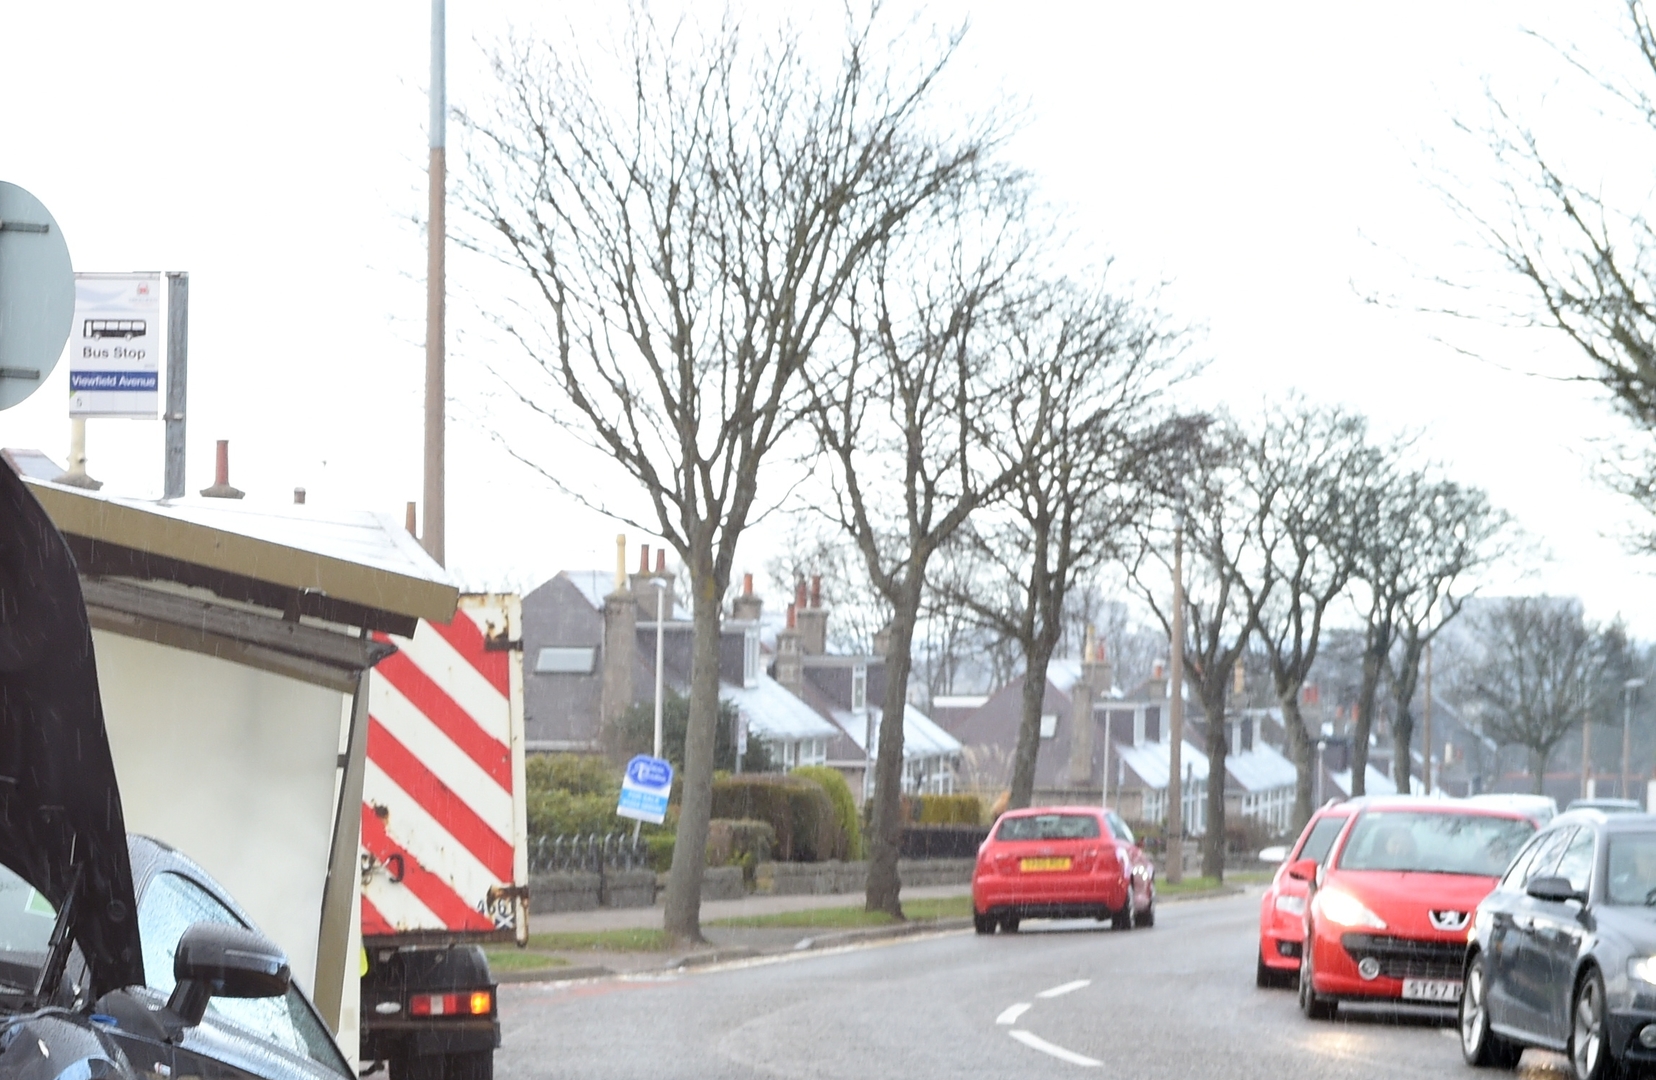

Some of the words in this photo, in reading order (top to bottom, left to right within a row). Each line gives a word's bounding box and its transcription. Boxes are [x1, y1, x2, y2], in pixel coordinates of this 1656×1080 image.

[83, 346, 109, 358] Bus
[114, 346, 146, 360] Stop
[72, 374, 117, 387] Viewfield
[118, 375, 156, 387] Avenue
